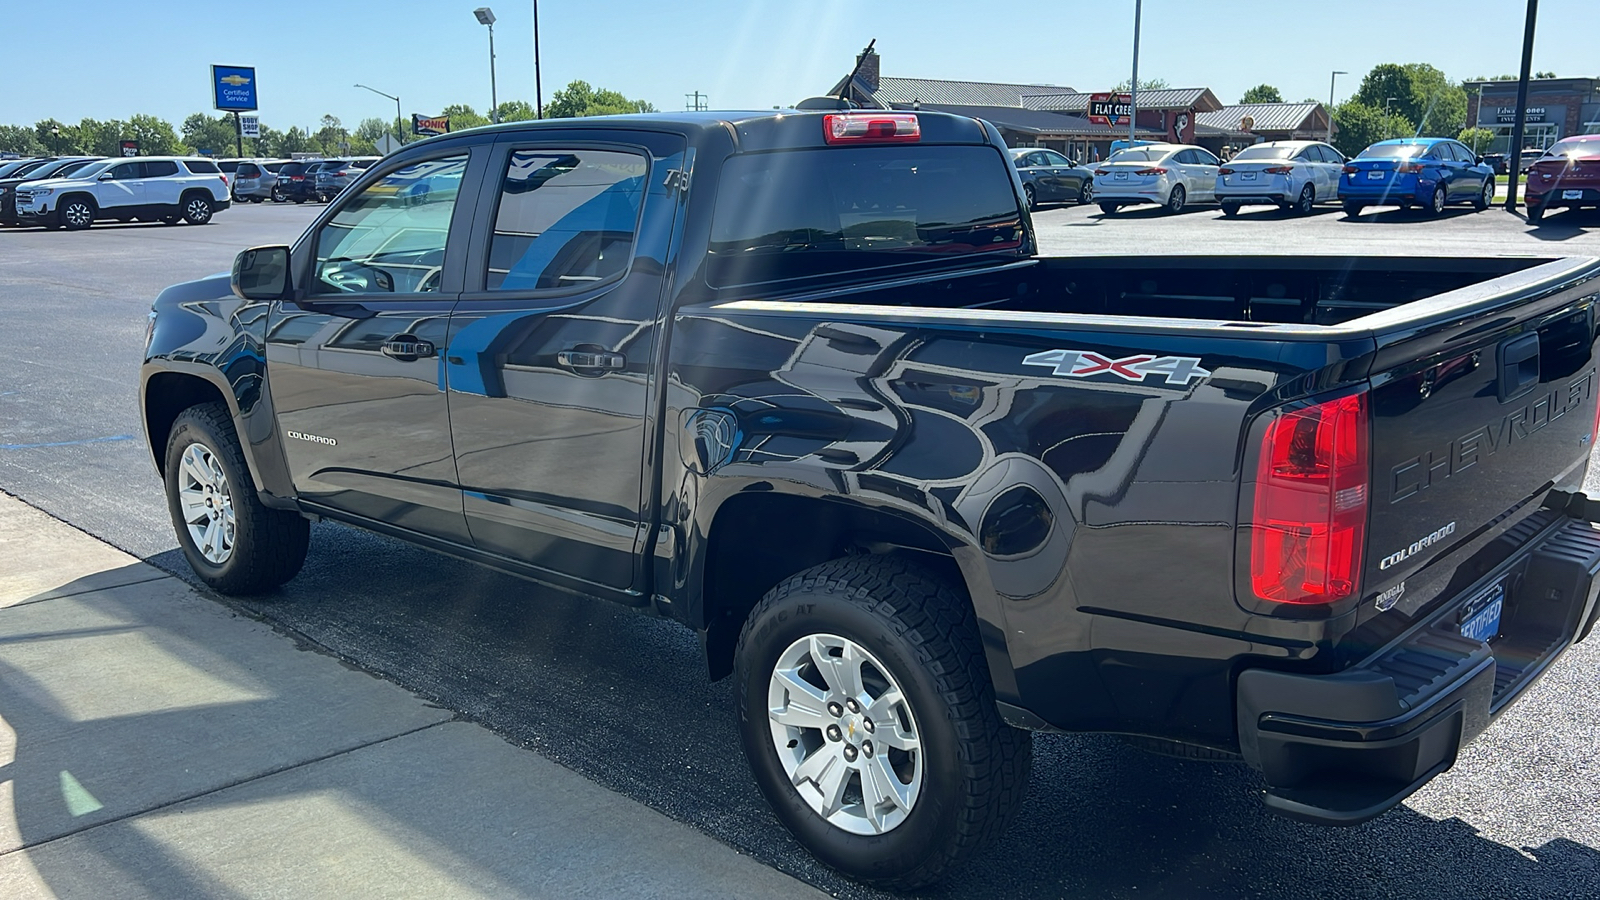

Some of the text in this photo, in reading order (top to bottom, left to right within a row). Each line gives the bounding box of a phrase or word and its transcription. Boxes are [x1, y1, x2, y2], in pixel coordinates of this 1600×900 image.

[223, 89, 250, 97] Certified
[1095, 104, 1132, 115] FLAT CREE
[418, 119, 446, 129] SONIC
[287, 430, 337, 446] COLORADO
[1389, 367, 1597, 505] CHEVROLET
[1380, 521, 1456, 571] COLORADO
[1375, 581, 1405, 606] PINEGAR
